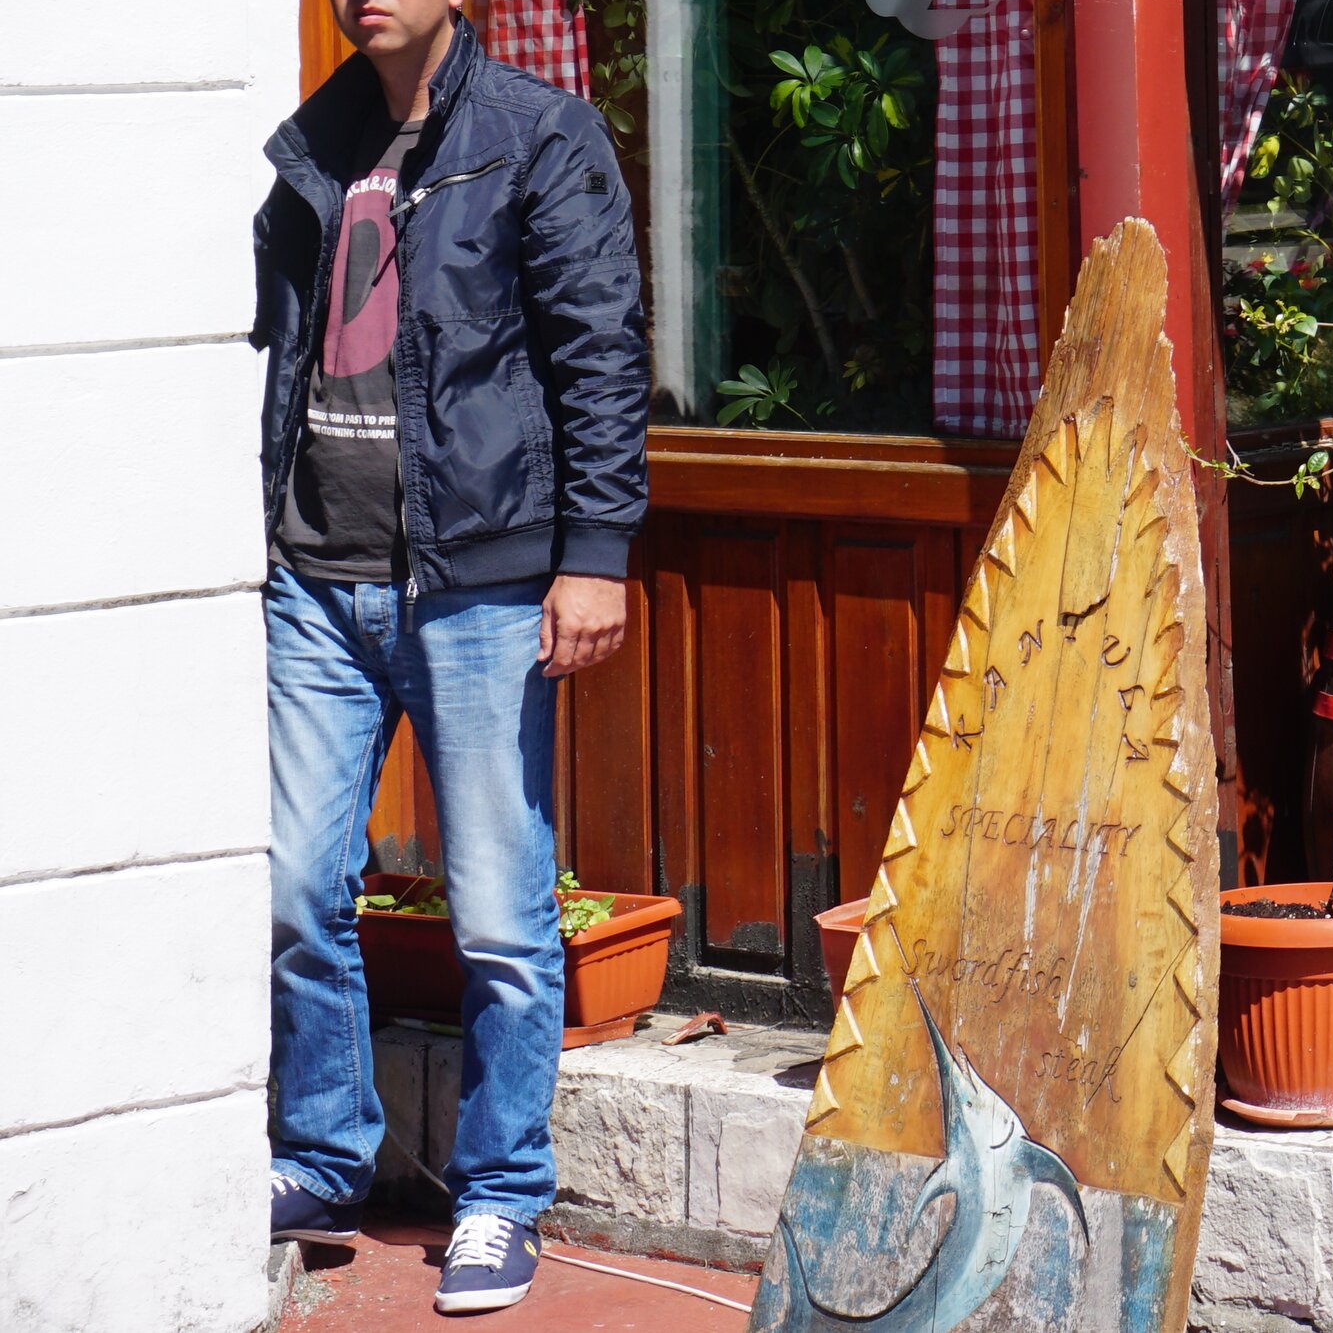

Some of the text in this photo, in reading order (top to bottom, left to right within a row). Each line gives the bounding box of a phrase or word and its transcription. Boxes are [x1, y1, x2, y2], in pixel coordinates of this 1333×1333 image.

[321, 426, 355, 439] CLOTHING
[356, 429, 395, 440] COMPAN
[345, 414, 362, 425] PAST
[363, 415, 376, 425] TO
[377, 415, 396, 426] PRE
[952, 613, 1150, 764] KANTULA
[941, 804, 1142, 858] SPECIALITY
[900, 939, 1066, 1004] Swordfish
[1034, 1045, 1122, 1104] steak
